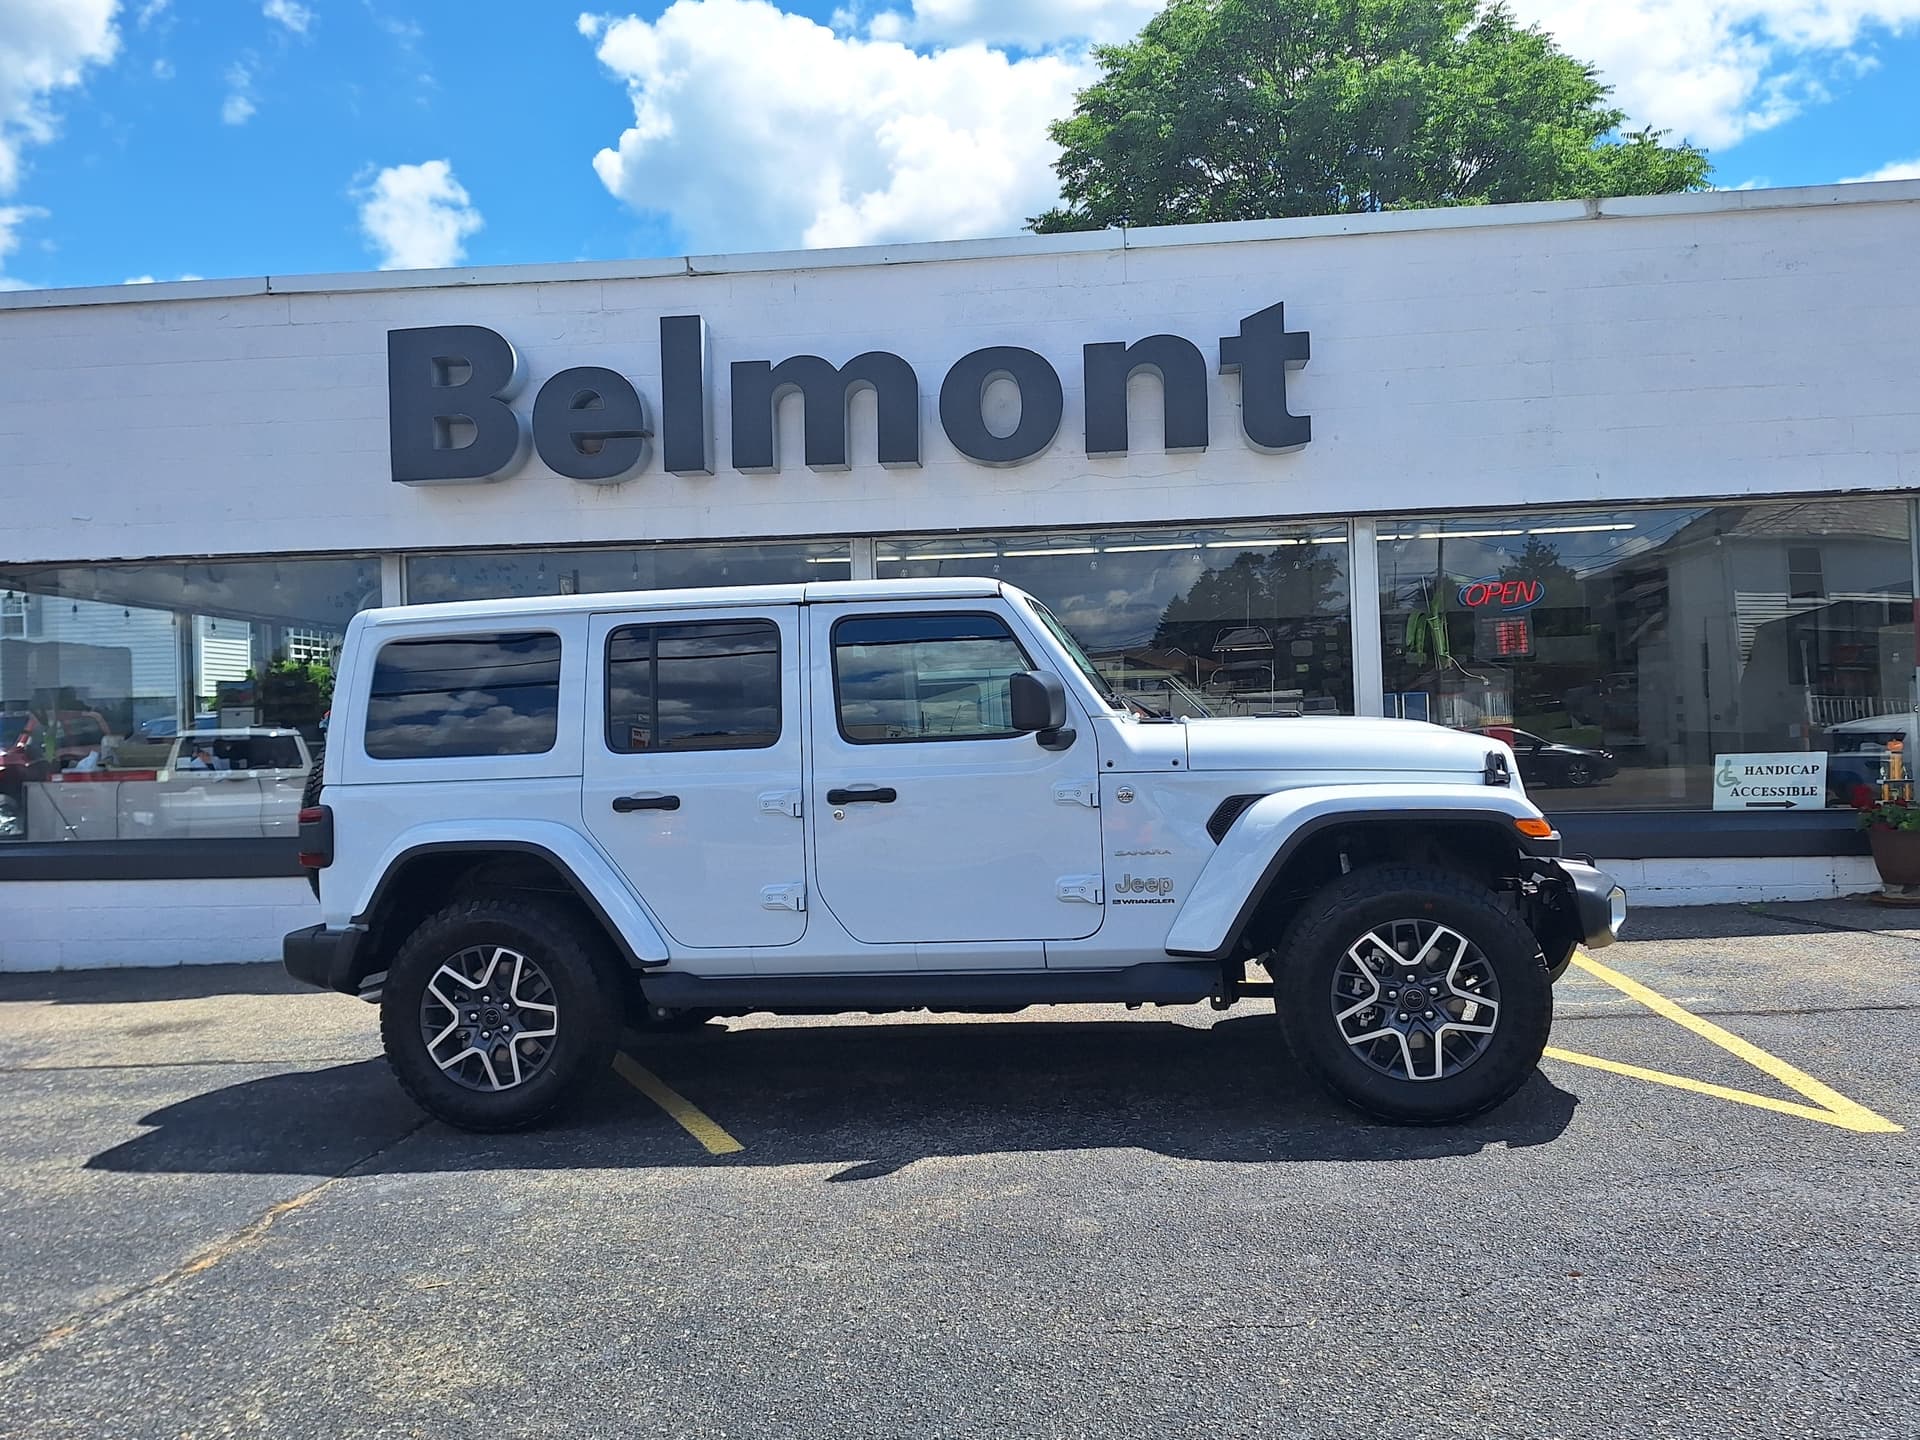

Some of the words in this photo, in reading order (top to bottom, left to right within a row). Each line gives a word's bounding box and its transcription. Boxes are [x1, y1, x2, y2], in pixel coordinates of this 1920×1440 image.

[387, 301, 1312, 484] Belmont
[1465, 580, 1537, 606] OPEN
[1744, 765, 1820, 775] HANDICAP
[1730, 786, 1818, 797] ACCESSIBLE
[1115, 873, 1174, 896] Jeep
